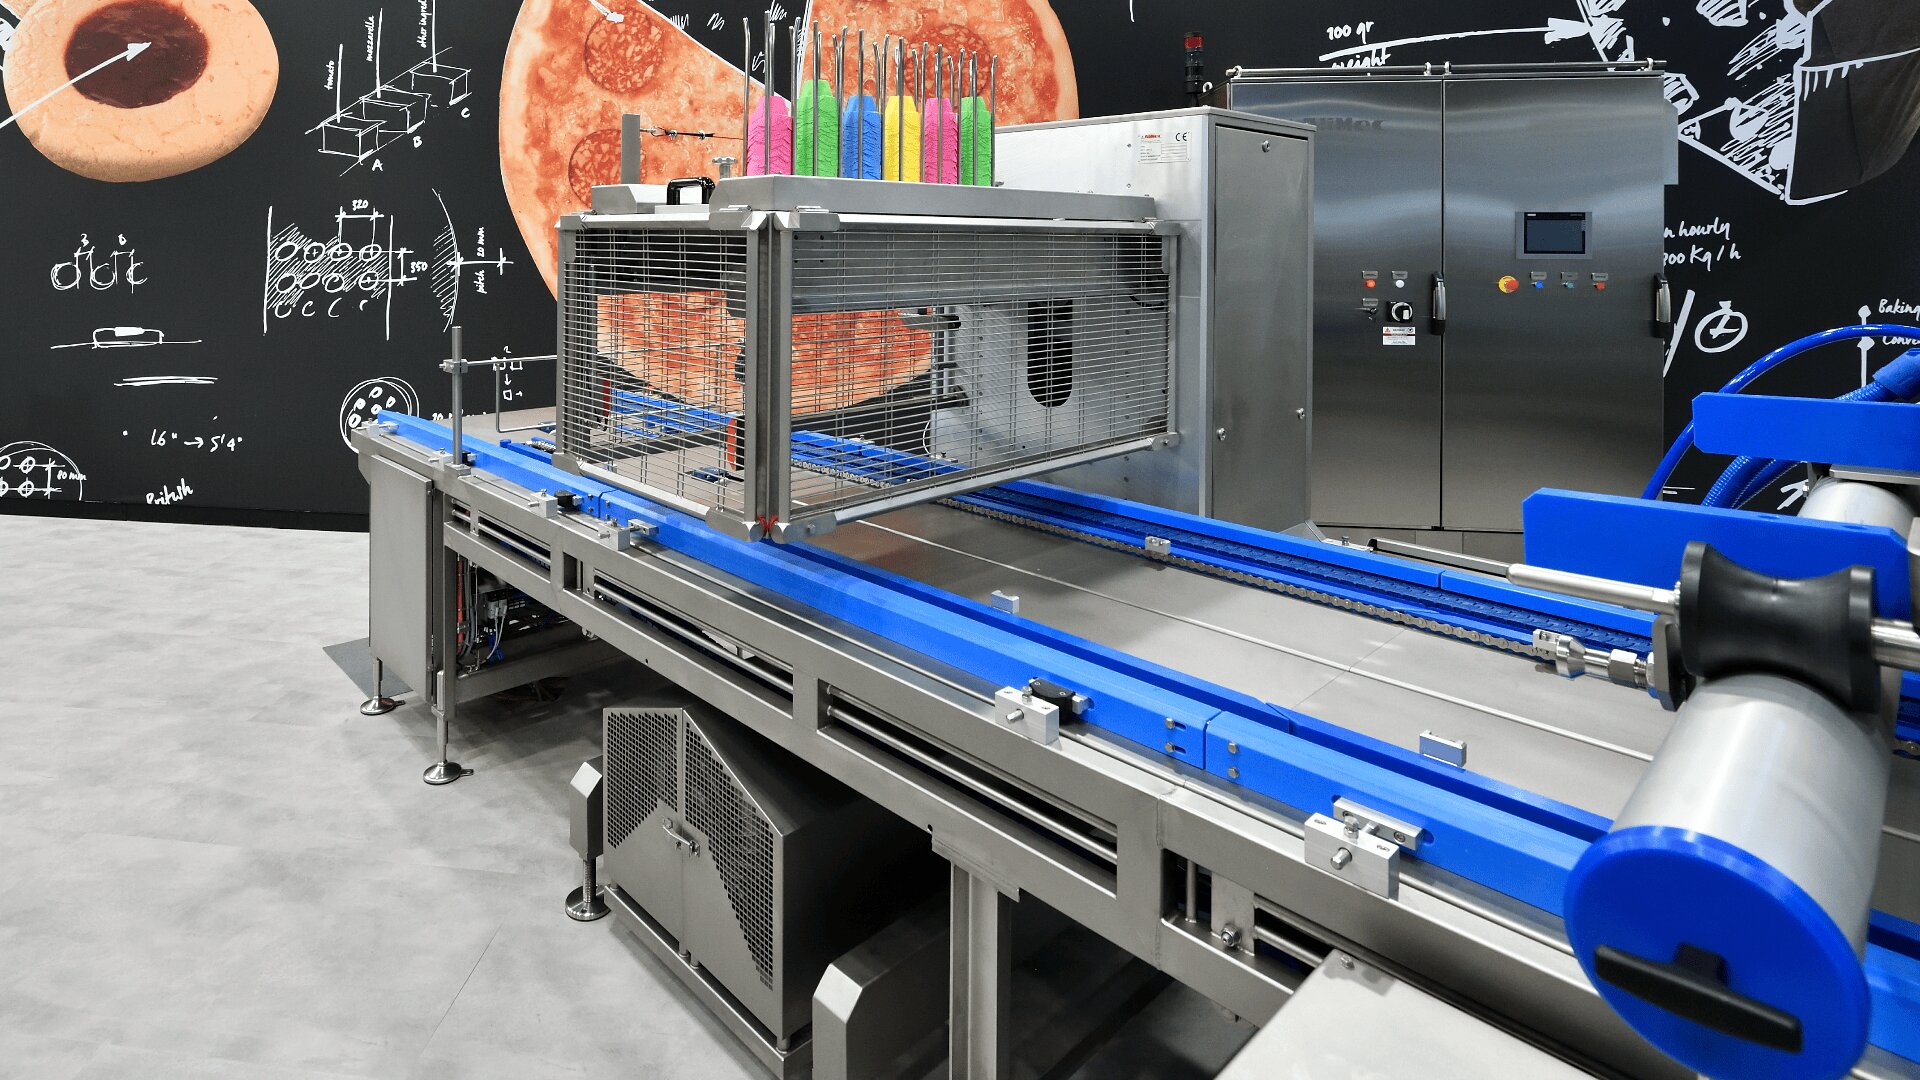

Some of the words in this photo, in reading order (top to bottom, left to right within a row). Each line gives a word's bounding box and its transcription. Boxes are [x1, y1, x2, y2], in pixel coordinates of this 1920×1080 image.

[416, 26, 427, 48] other
[1326, 24, 1352, 40] 100
[1355, 21, 1375, 45] gr
[323, 60, 335, 91] tomato
[460, 107, 471, 118] C
[412, 135, 423, 148] B
[371, 158, 384, 172] A
[352, 199, 369, 212] 320
[1678, 216, 1731, 241] hourly
[410, 261, 429, 274] 350
[473, 269, 488, 294] pitch
[1878, 298, 1920, 322] Baking
